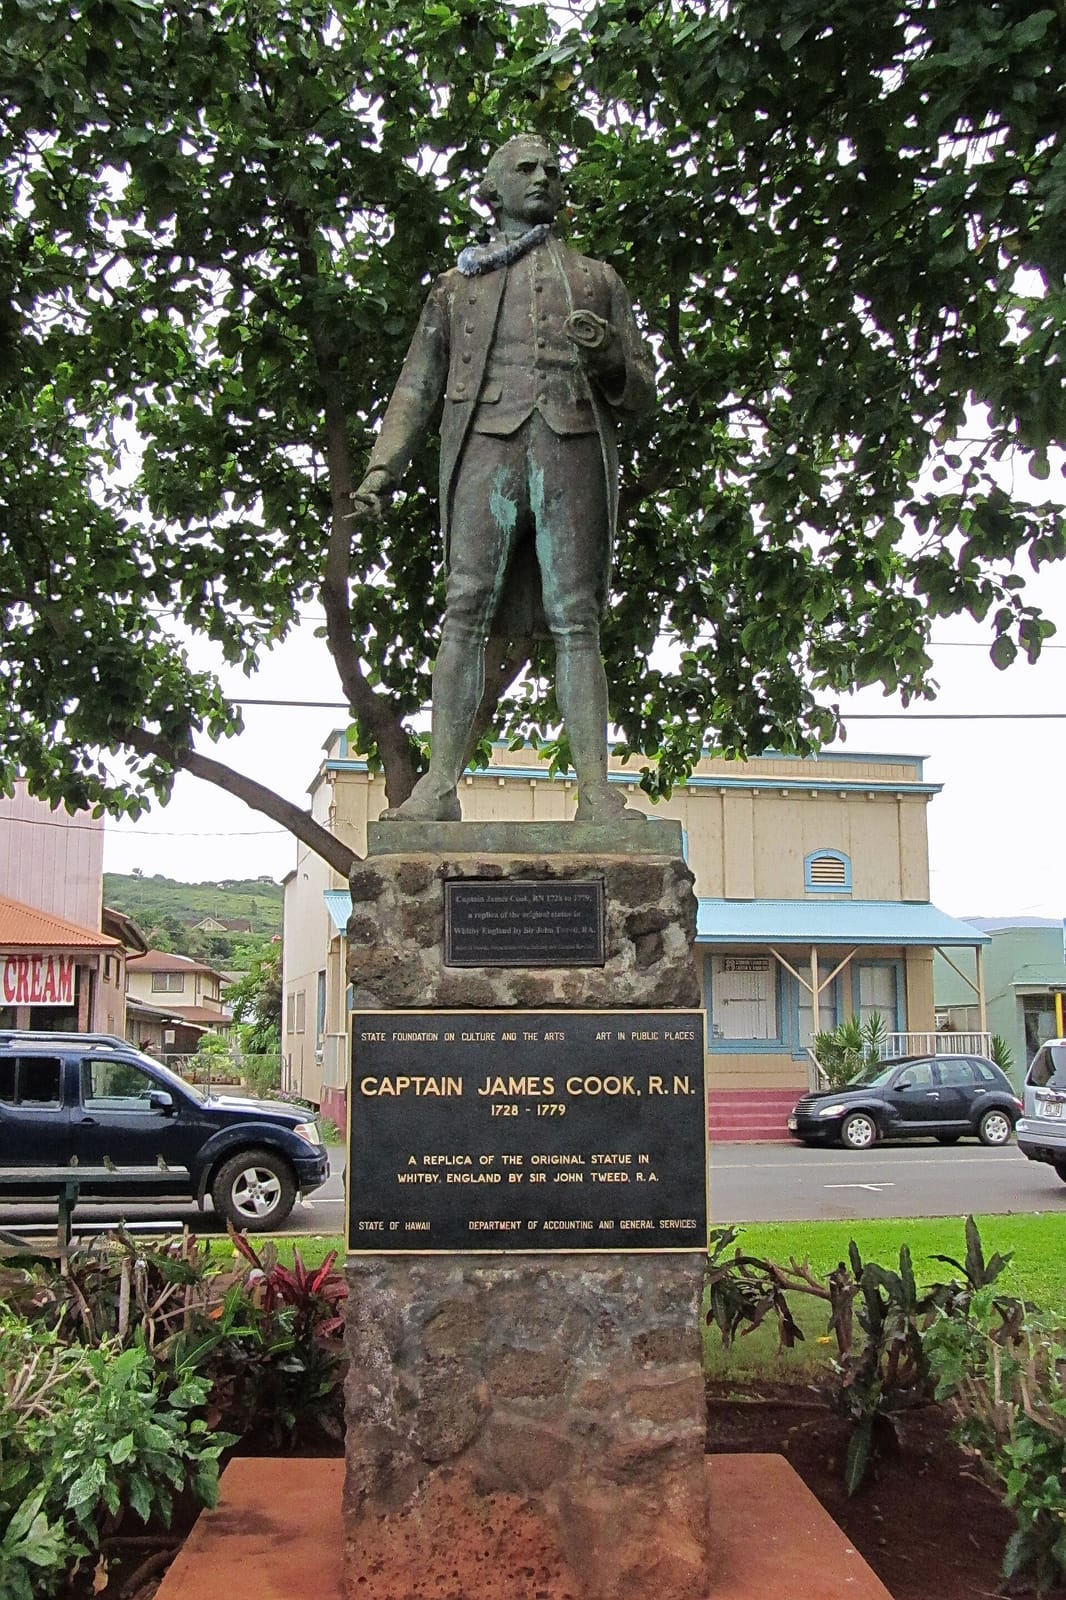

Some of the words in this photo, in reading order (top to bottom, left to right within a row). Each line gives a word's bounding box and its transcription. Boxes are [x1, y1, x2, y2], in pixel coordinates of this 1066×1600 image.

[3, 953, 74, 1003] CREAM
[361, 1032, 386, 1042] STATE
[392, 1032, 439, 1042] FOUNDATION
[444, 1032, 455, 1042] ON
[461, 1032, 496, 1042] CULTURE
[501, 1032, 517, 1041] AND
[522, 1032, 539, 1041] THE
[544, 1032, 565, 1041] ARTS
[595, 1031, 612, 1041] ART
[617, 1031, 626, 1041] IN
[631, 1031, 659, 1041] PUBLIC
[664, 1031, 695, 1040] PLACES
[360, 1076, 463, 1096] CAPTAIN
[477, 1076, 555, 1096] JAMES
[566, 1076, 641, 1097] COOK,
[491, 1104, 519, 1116] 1728
[537, 1104, 566, 1116] 1779
[408, 1155, 417, 1165] A
[423, 1155, 472, 1165] REPLICA
[479, 1155, 495, 1165] OF
[501, 1155, 523, 1165] THE
[530, 1155, 586, 1165] ORIGINAL
[591, 1154, 632, 1164] STATUE
[638, 1154, 649, 1164] IN
[446, 1173, 501, 1183] ENGLAND
[508, 1173, 523, 1183] BY
[529, 1173, 547, 1183] SIR
[553, 1172, 583, 1183] JOHN
[358, 1221, 385, 1231] STATE
[389, 1221, 401, 1231] OF
[404, 1221, 431, 1231] HAWAII
[468, 1220, 522, 1230] DEPARTMENT
[527, 1220, 539, 1230] OF
[543, 1220, 593, 1230] ACCOUNTING
[598, 1220, 615, 1229] AND
[619, 1219, 656, 1230] GENERAL
[659, 1219, 697, 1229] SERVICES
